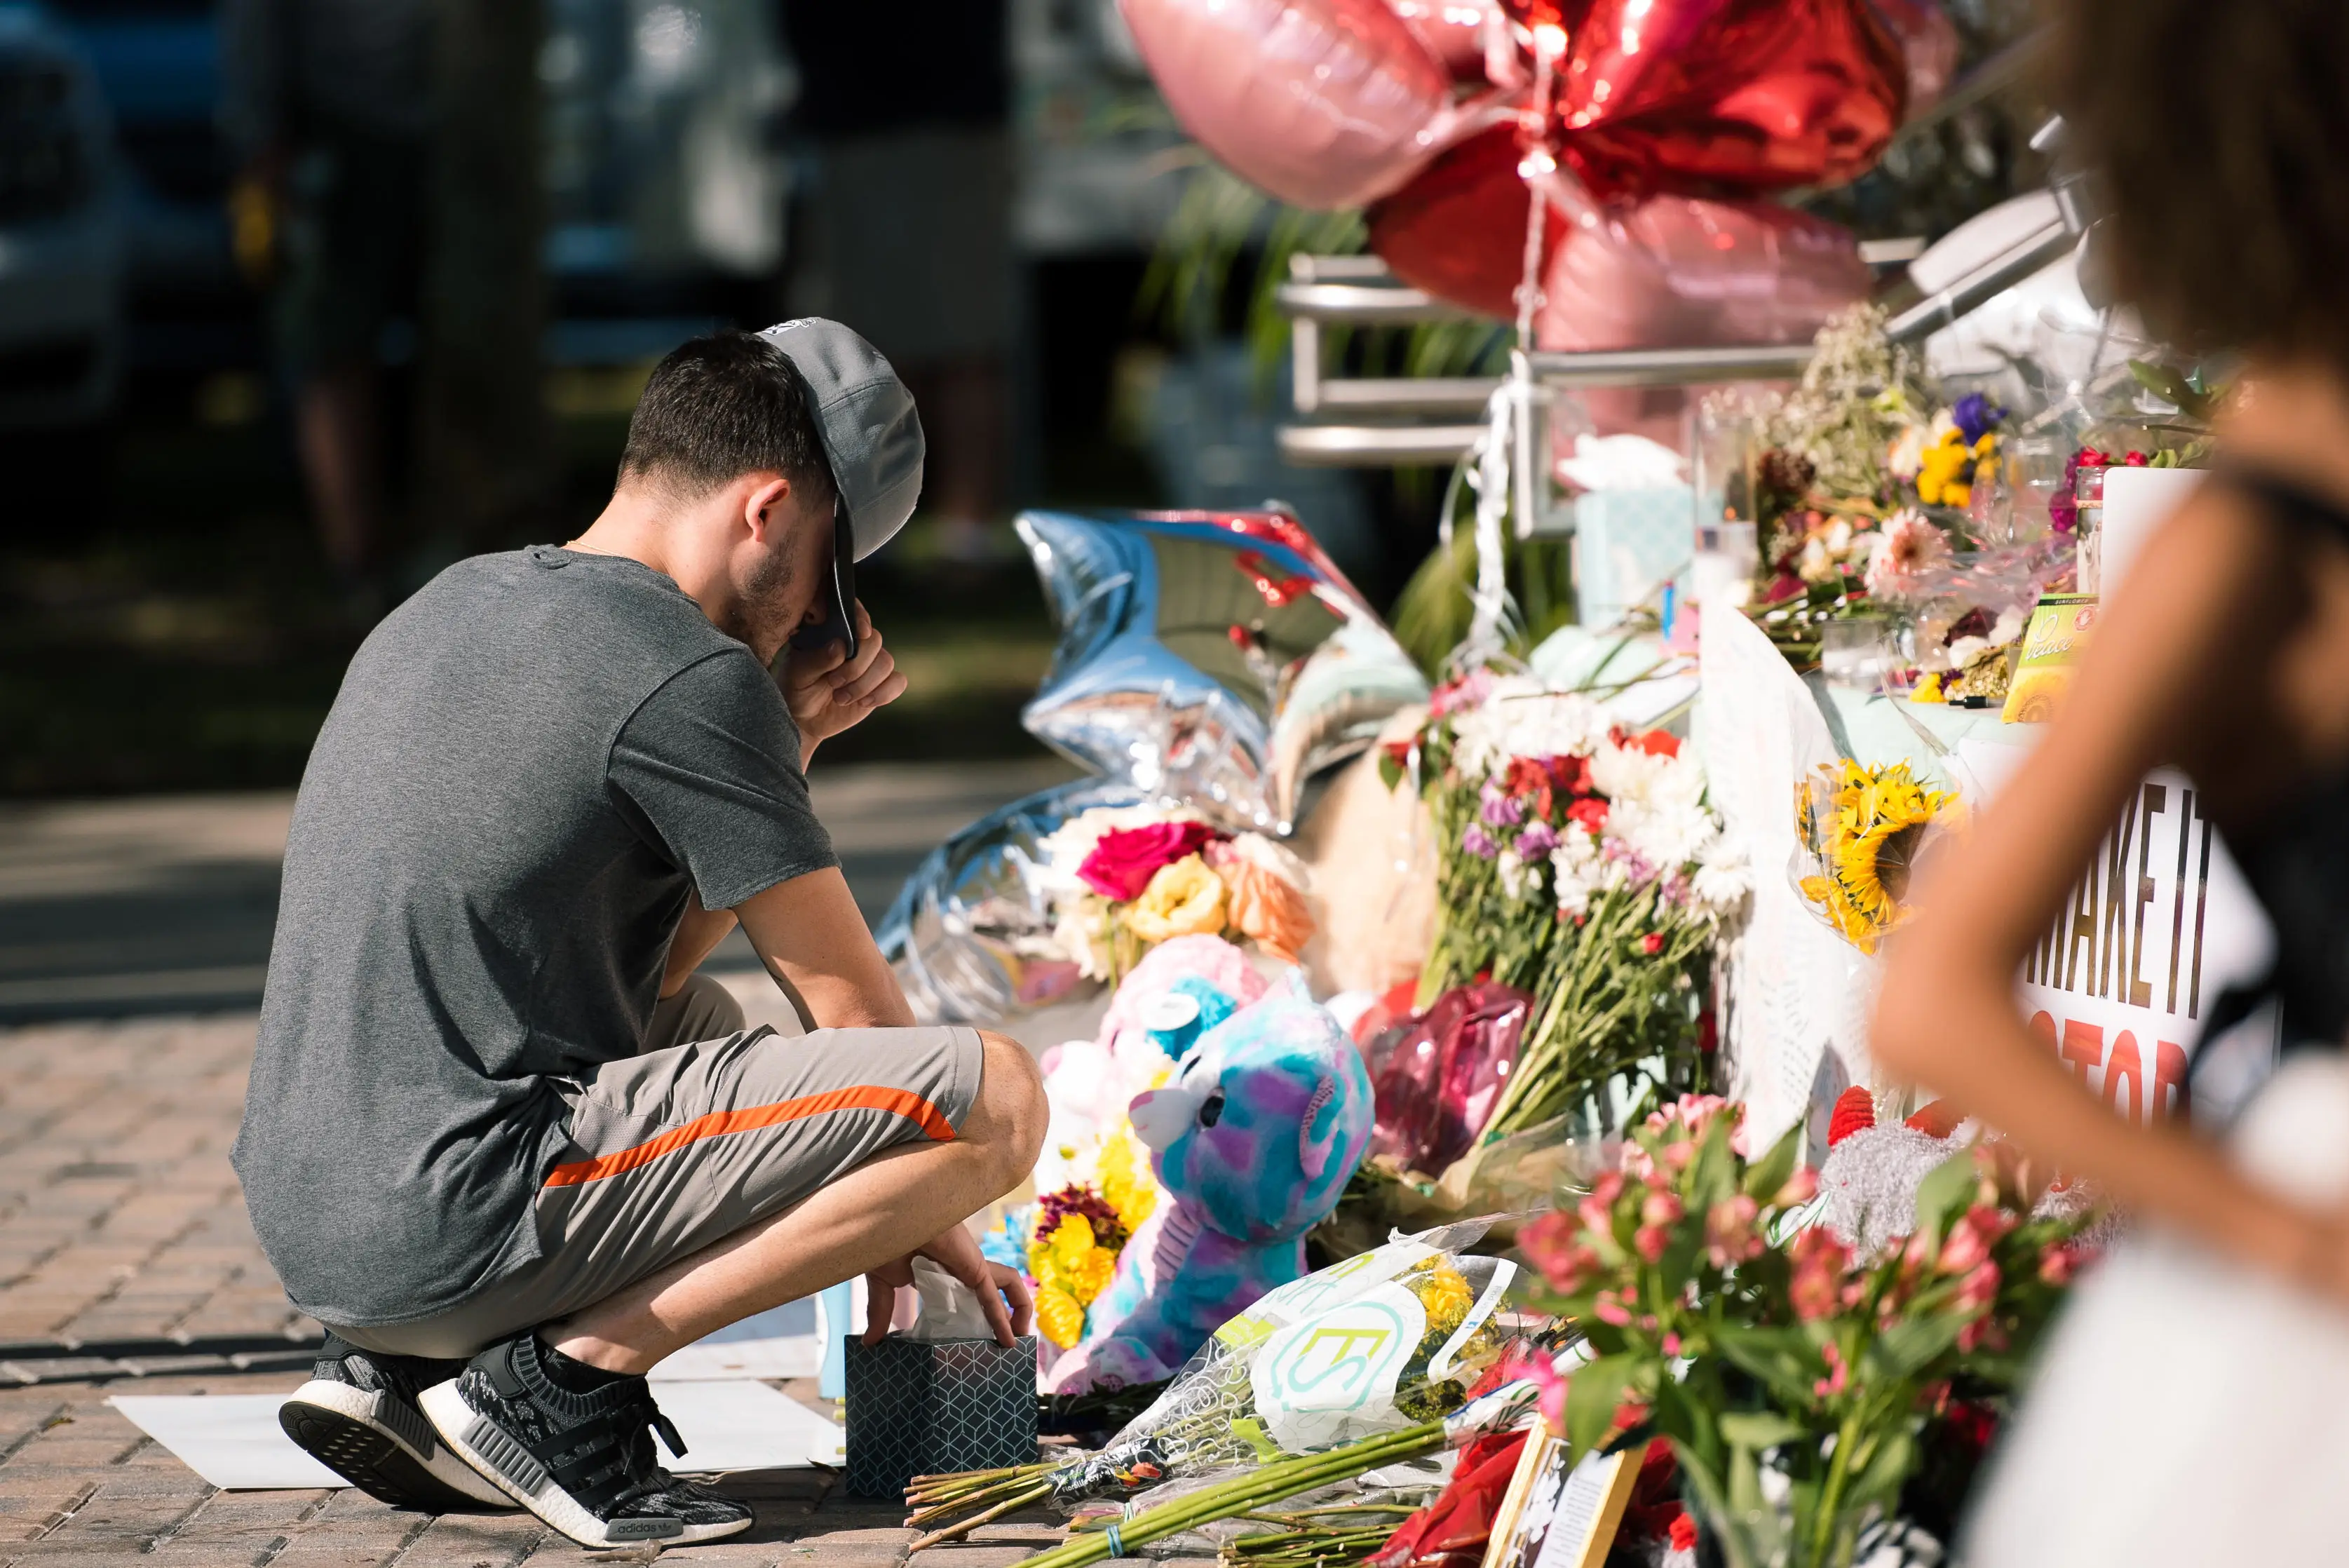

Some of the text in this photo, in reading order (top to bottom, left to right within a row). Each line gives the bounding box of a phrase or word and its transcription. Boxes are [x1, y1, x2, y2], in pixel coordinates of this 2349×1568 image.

[2026, 614, 2073, 661] Peace
[2166, 789, 2214, 1020] IT
[618, 1523, 656, 1534] adidas
